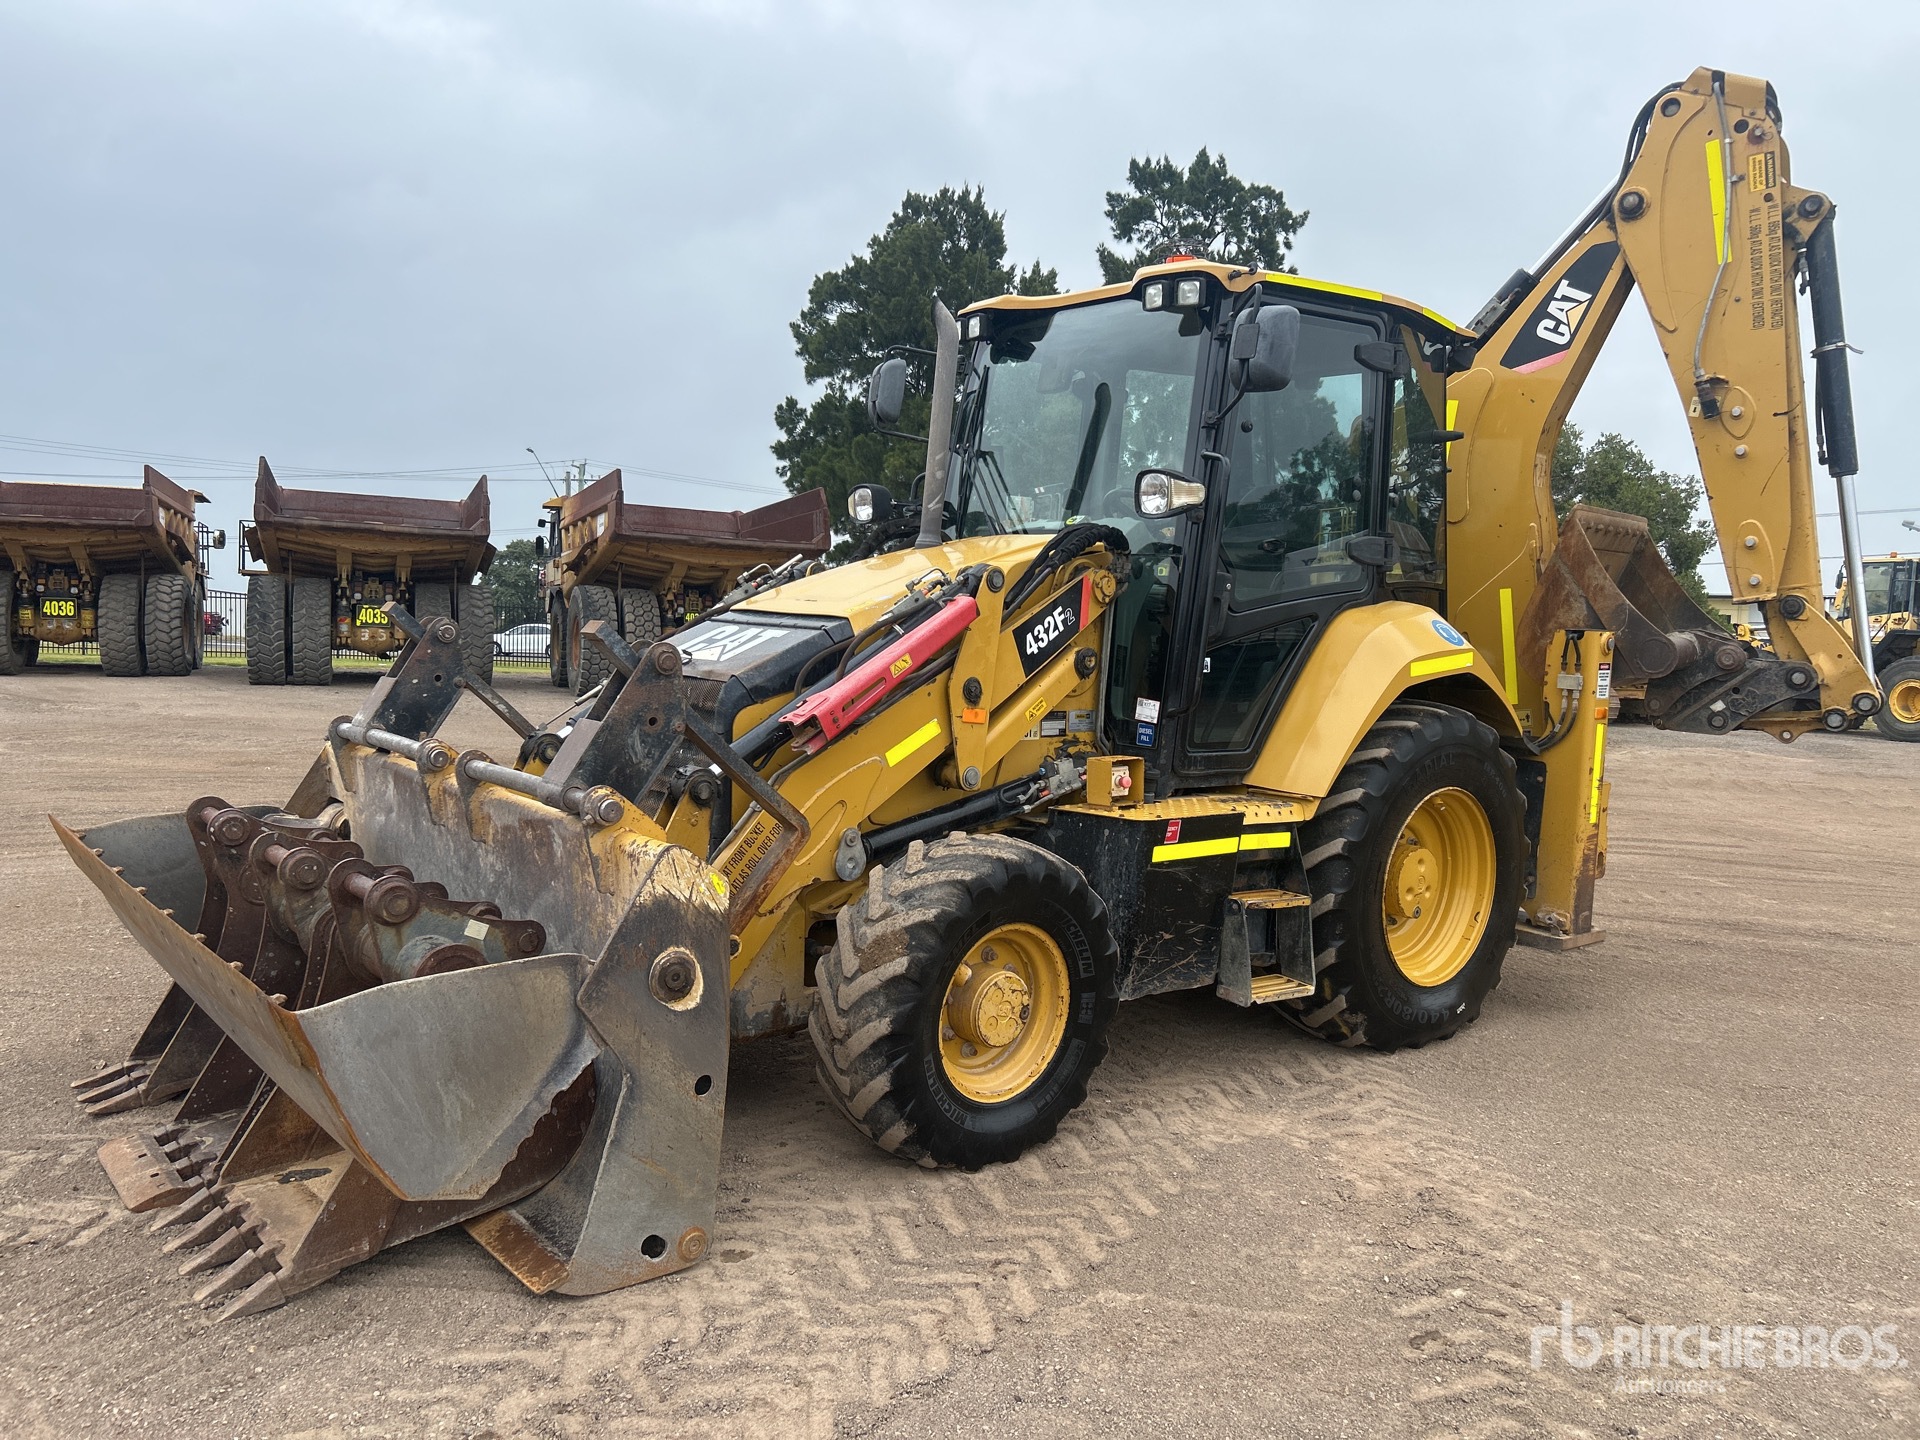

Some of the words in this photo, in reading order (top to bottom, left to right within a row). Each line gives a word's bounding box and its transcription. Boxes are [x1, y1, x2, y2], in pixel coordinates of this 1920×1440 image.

[1767, 159, 1775, 187] WARNING
[1750, 240, 1763, 256] ATLAS
[1769, 236, 1781, 252] ATLAS
[1750, 255, 1763, 271] QUICK
[1769, 252, 1782, 268] QUICK
[1751, 271, 1763, 287] HITCH
[1769, 268, 1782, 284] HITCH
[1751, 286, 1764, 300] ONLY
[1769, 284, 1782, 297] ONLY
[1536, 278, 1593, 345] CAT
[1750, 300, 1765, 331] (EXTENDED)
[1768, 297, 1783, 331] (RETRACTED)
[43, 601, 75, 616] 4036
[359, 608, 388, 624] 4035
[1026, 605, 1076, 656] 432F2
[679, 625, 790, 662] CAT
[1138, 727, 1153, 735] DIESEL
[1140, 734, 1150, 742] FILL
[728, 844, 748, 870] FRONT
[731, 868, 750, 893] ATLAS
[744, 853, 763, 873] ROLL
[757, 835, 775, 856] OVER
[924, 1058, 969, 1126] MICHELIN
